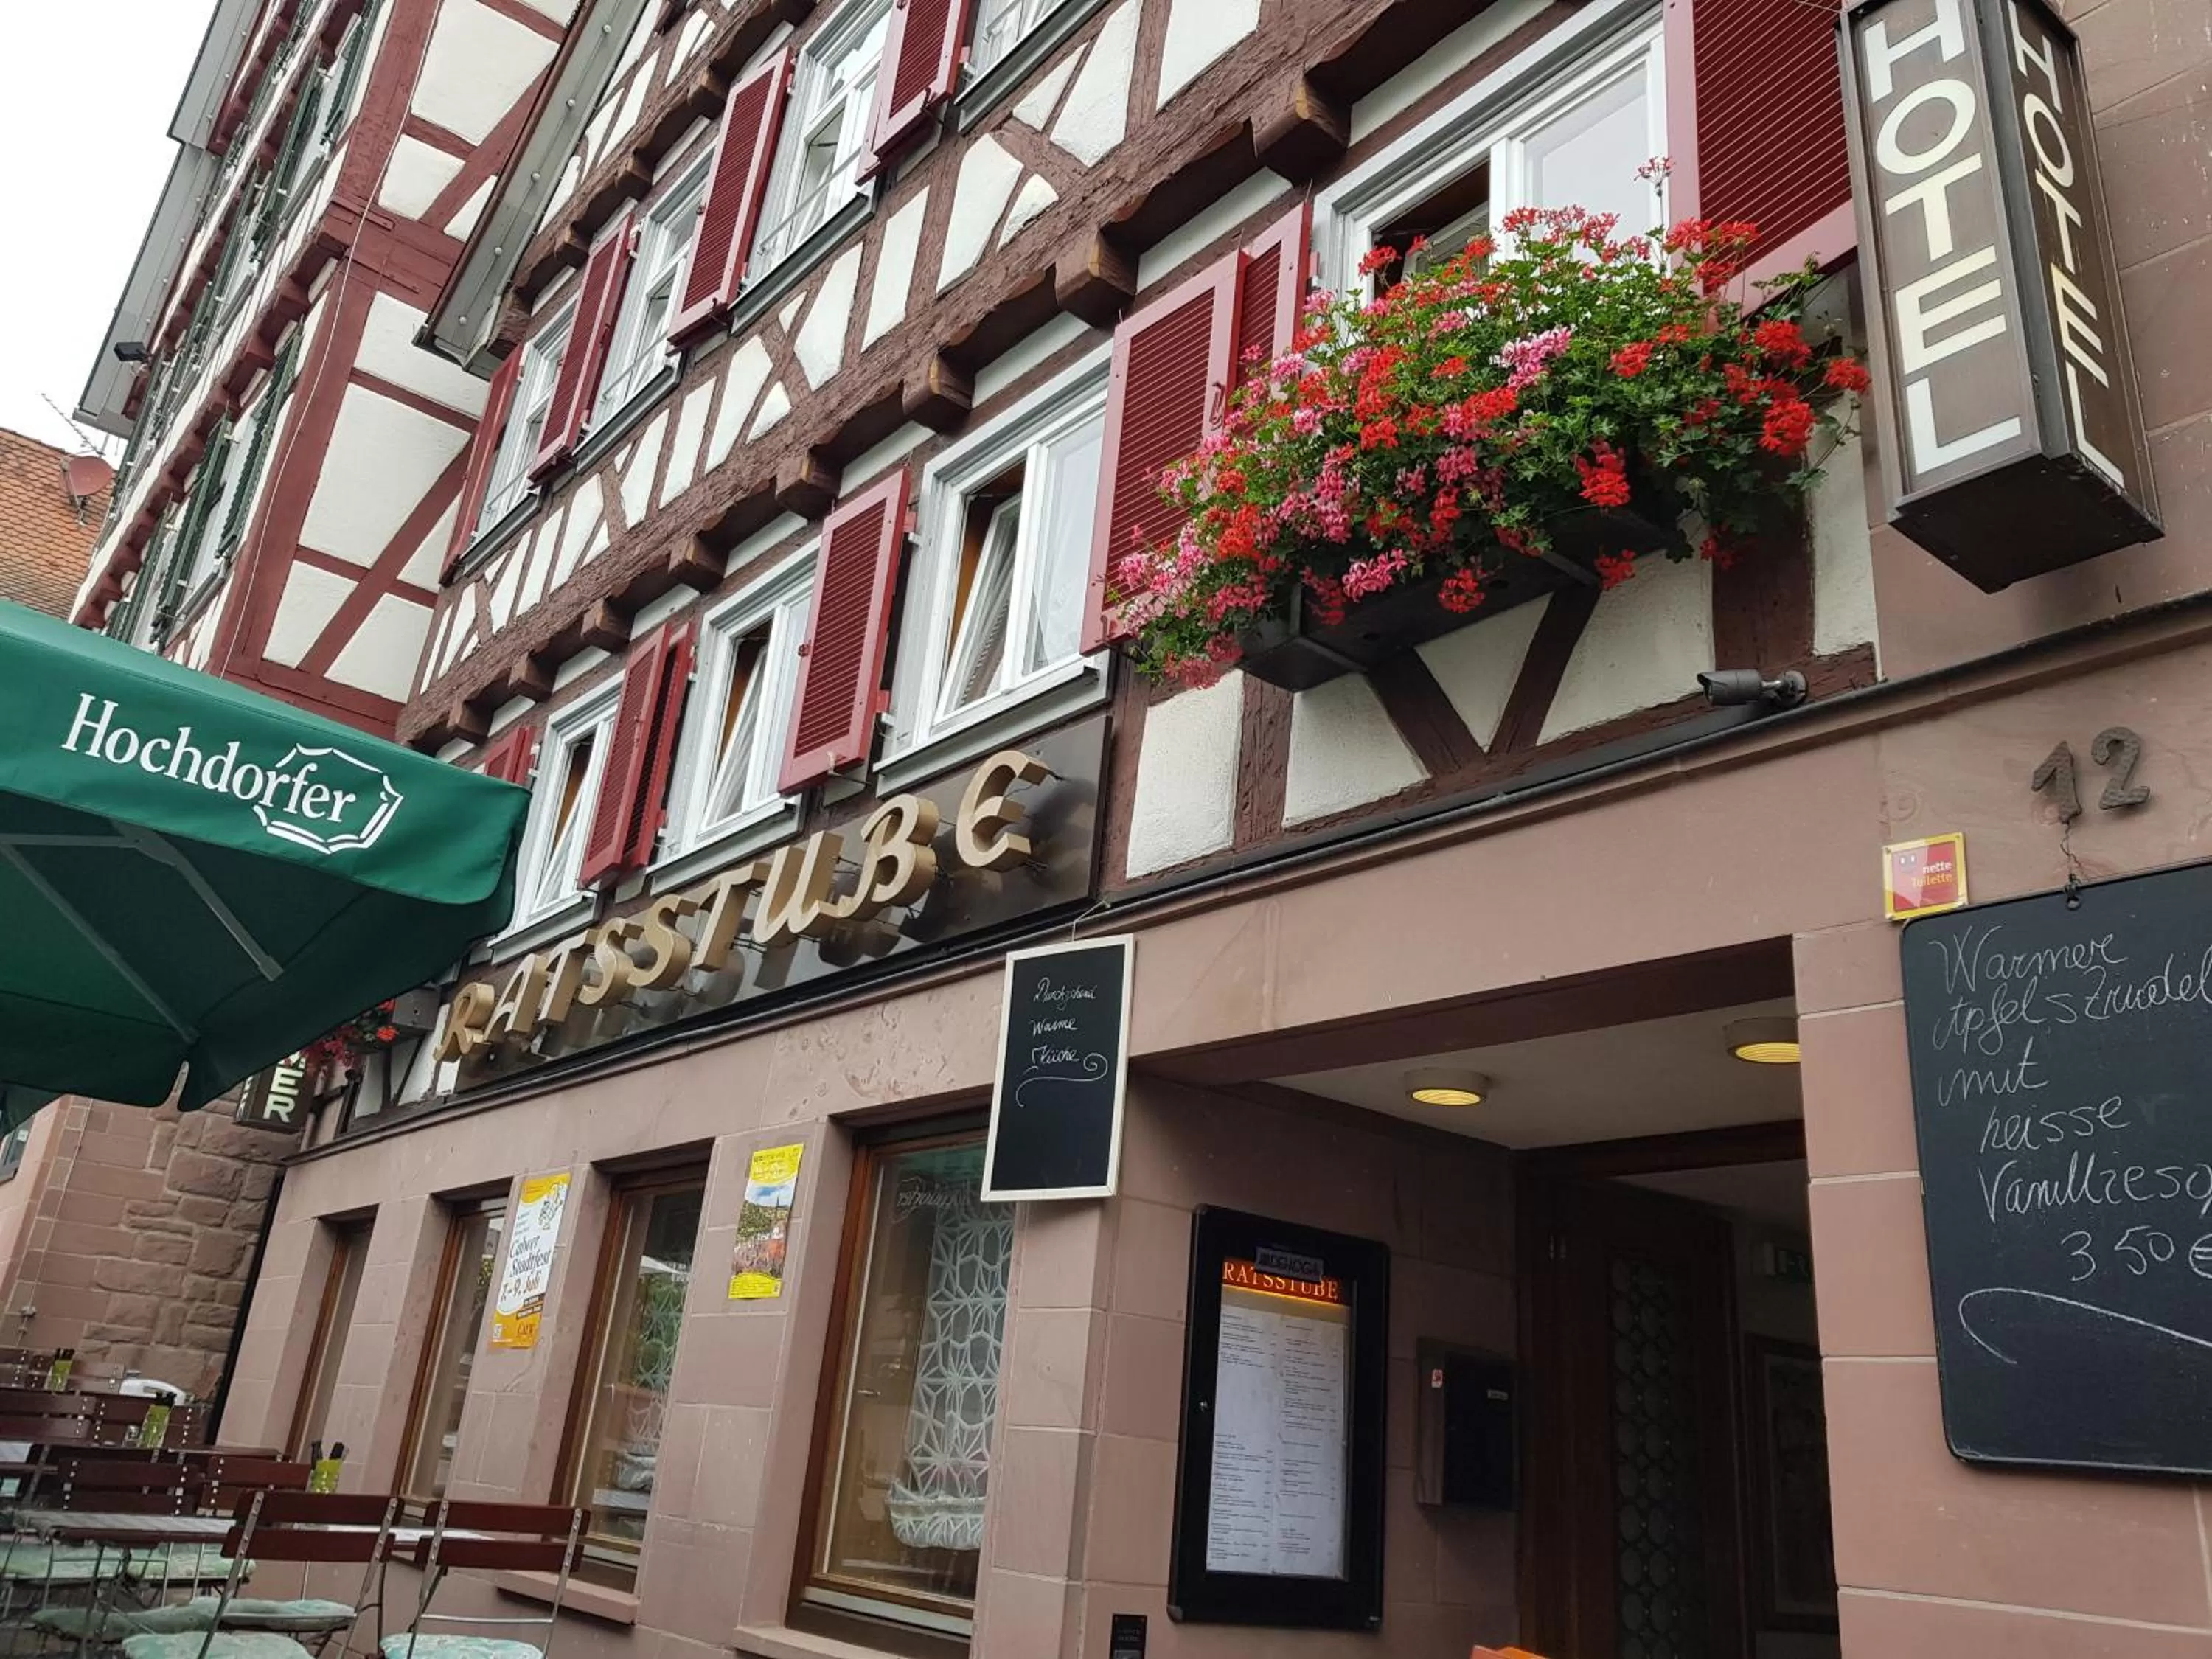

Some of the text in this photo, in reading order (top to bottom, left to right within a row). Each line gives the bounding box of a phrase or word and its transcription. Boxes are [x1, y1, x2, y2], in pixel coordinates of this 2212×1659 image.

[1864, 0, 2022, 474] HOTEL
[2008, 0, 2125, 488] HOTEL
[61, 693, 355, 822] Hochdorfer
[2031, 726, 2150, 821] 12
[434, 749, 1053, 1065] RATSSTUBE
[1922, 860, 1952, 874] nette
[1938, 1036, 2050, 1106] mit
